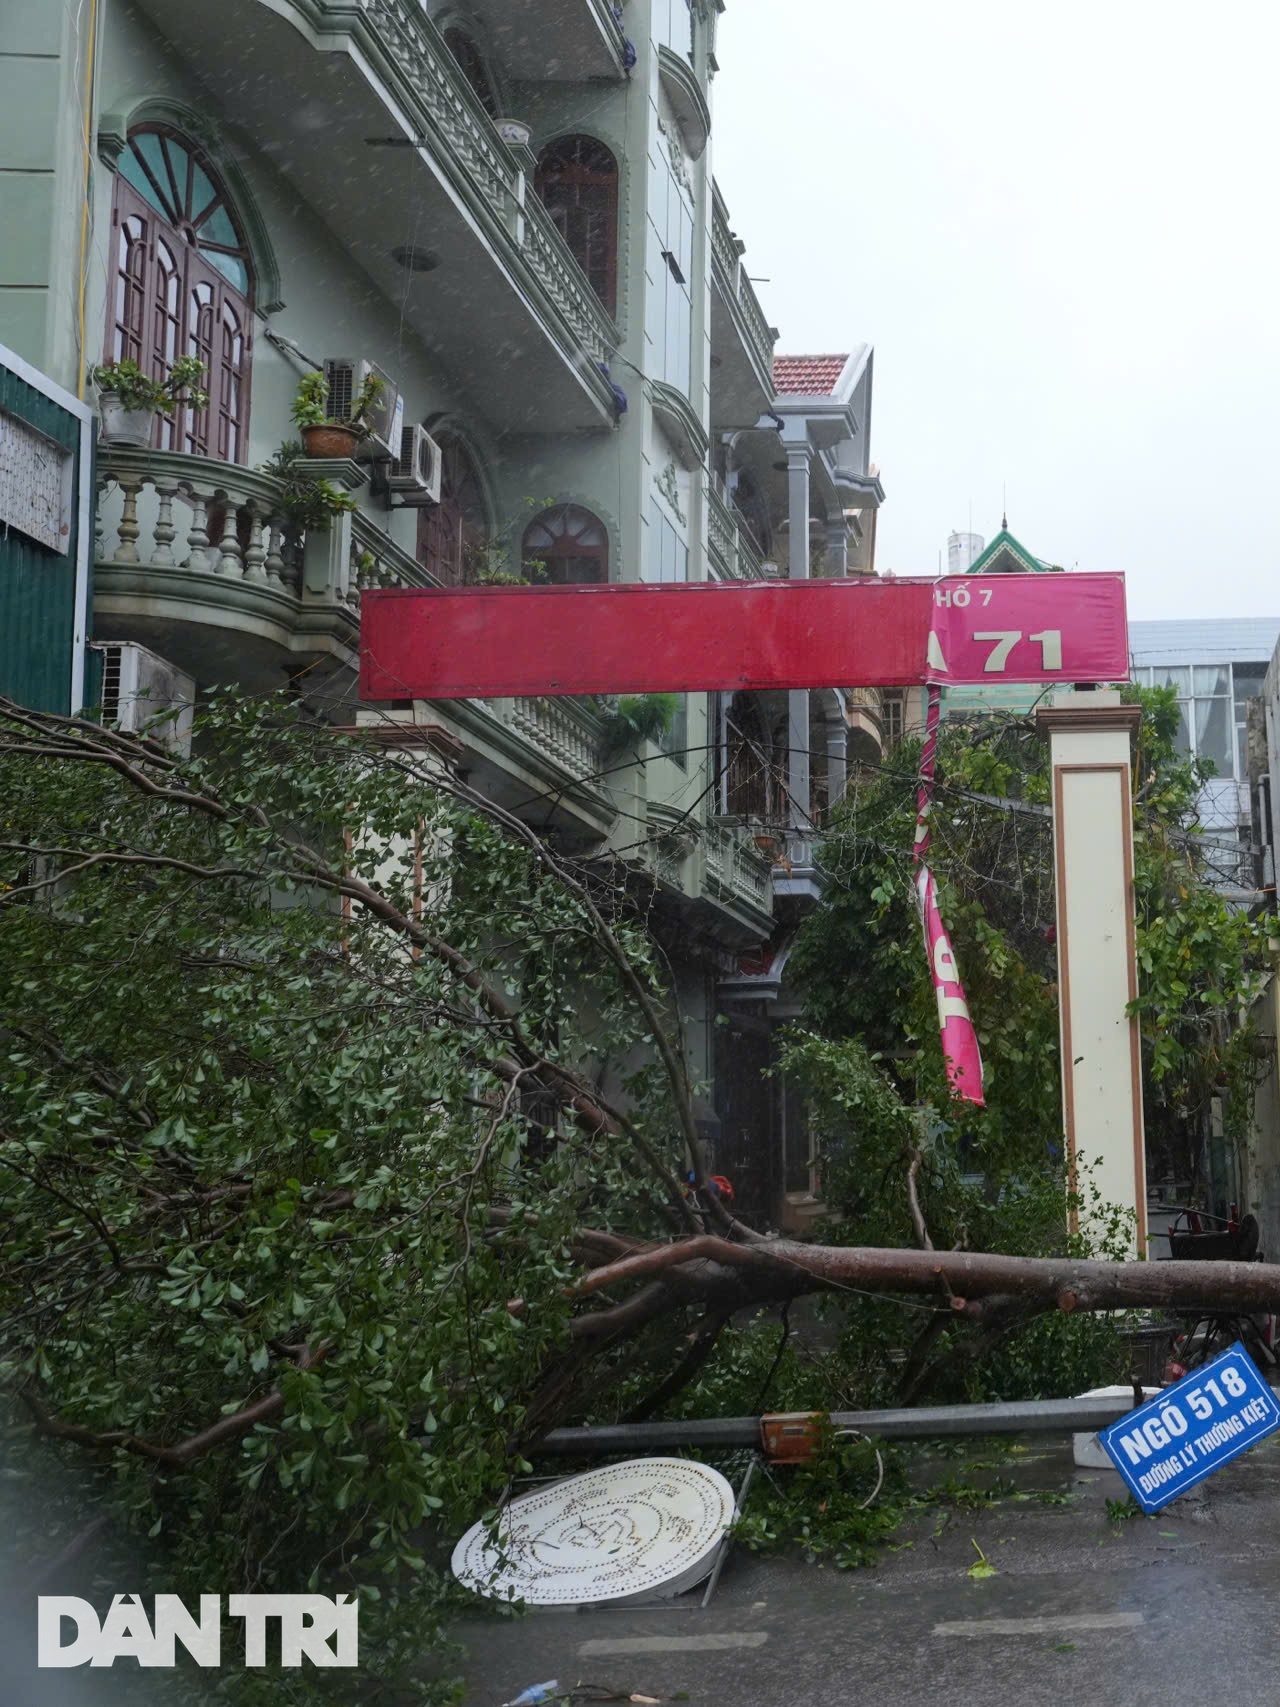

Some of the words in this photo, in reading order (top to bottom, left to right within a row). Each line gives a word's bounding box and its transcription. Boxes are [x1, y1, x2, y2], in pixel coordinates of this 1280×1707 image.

[933, 582, 971, 608] HỐ
[979, 589, 993, 607] 7
[973, 629, 1063, 672] 71
[1119, 1400, 1188, 1465] NGÕ
[1187, 1367, 1247, 1421] 518
[1138, 1454, 1183, 1495] ĐƯỜNG
[1183, 1440, 1199, 1468] LÝ
[1195, 1414, 1247, 1460] THƯỜNG
[1241, 1396, 1271, 1426] KIỆT
